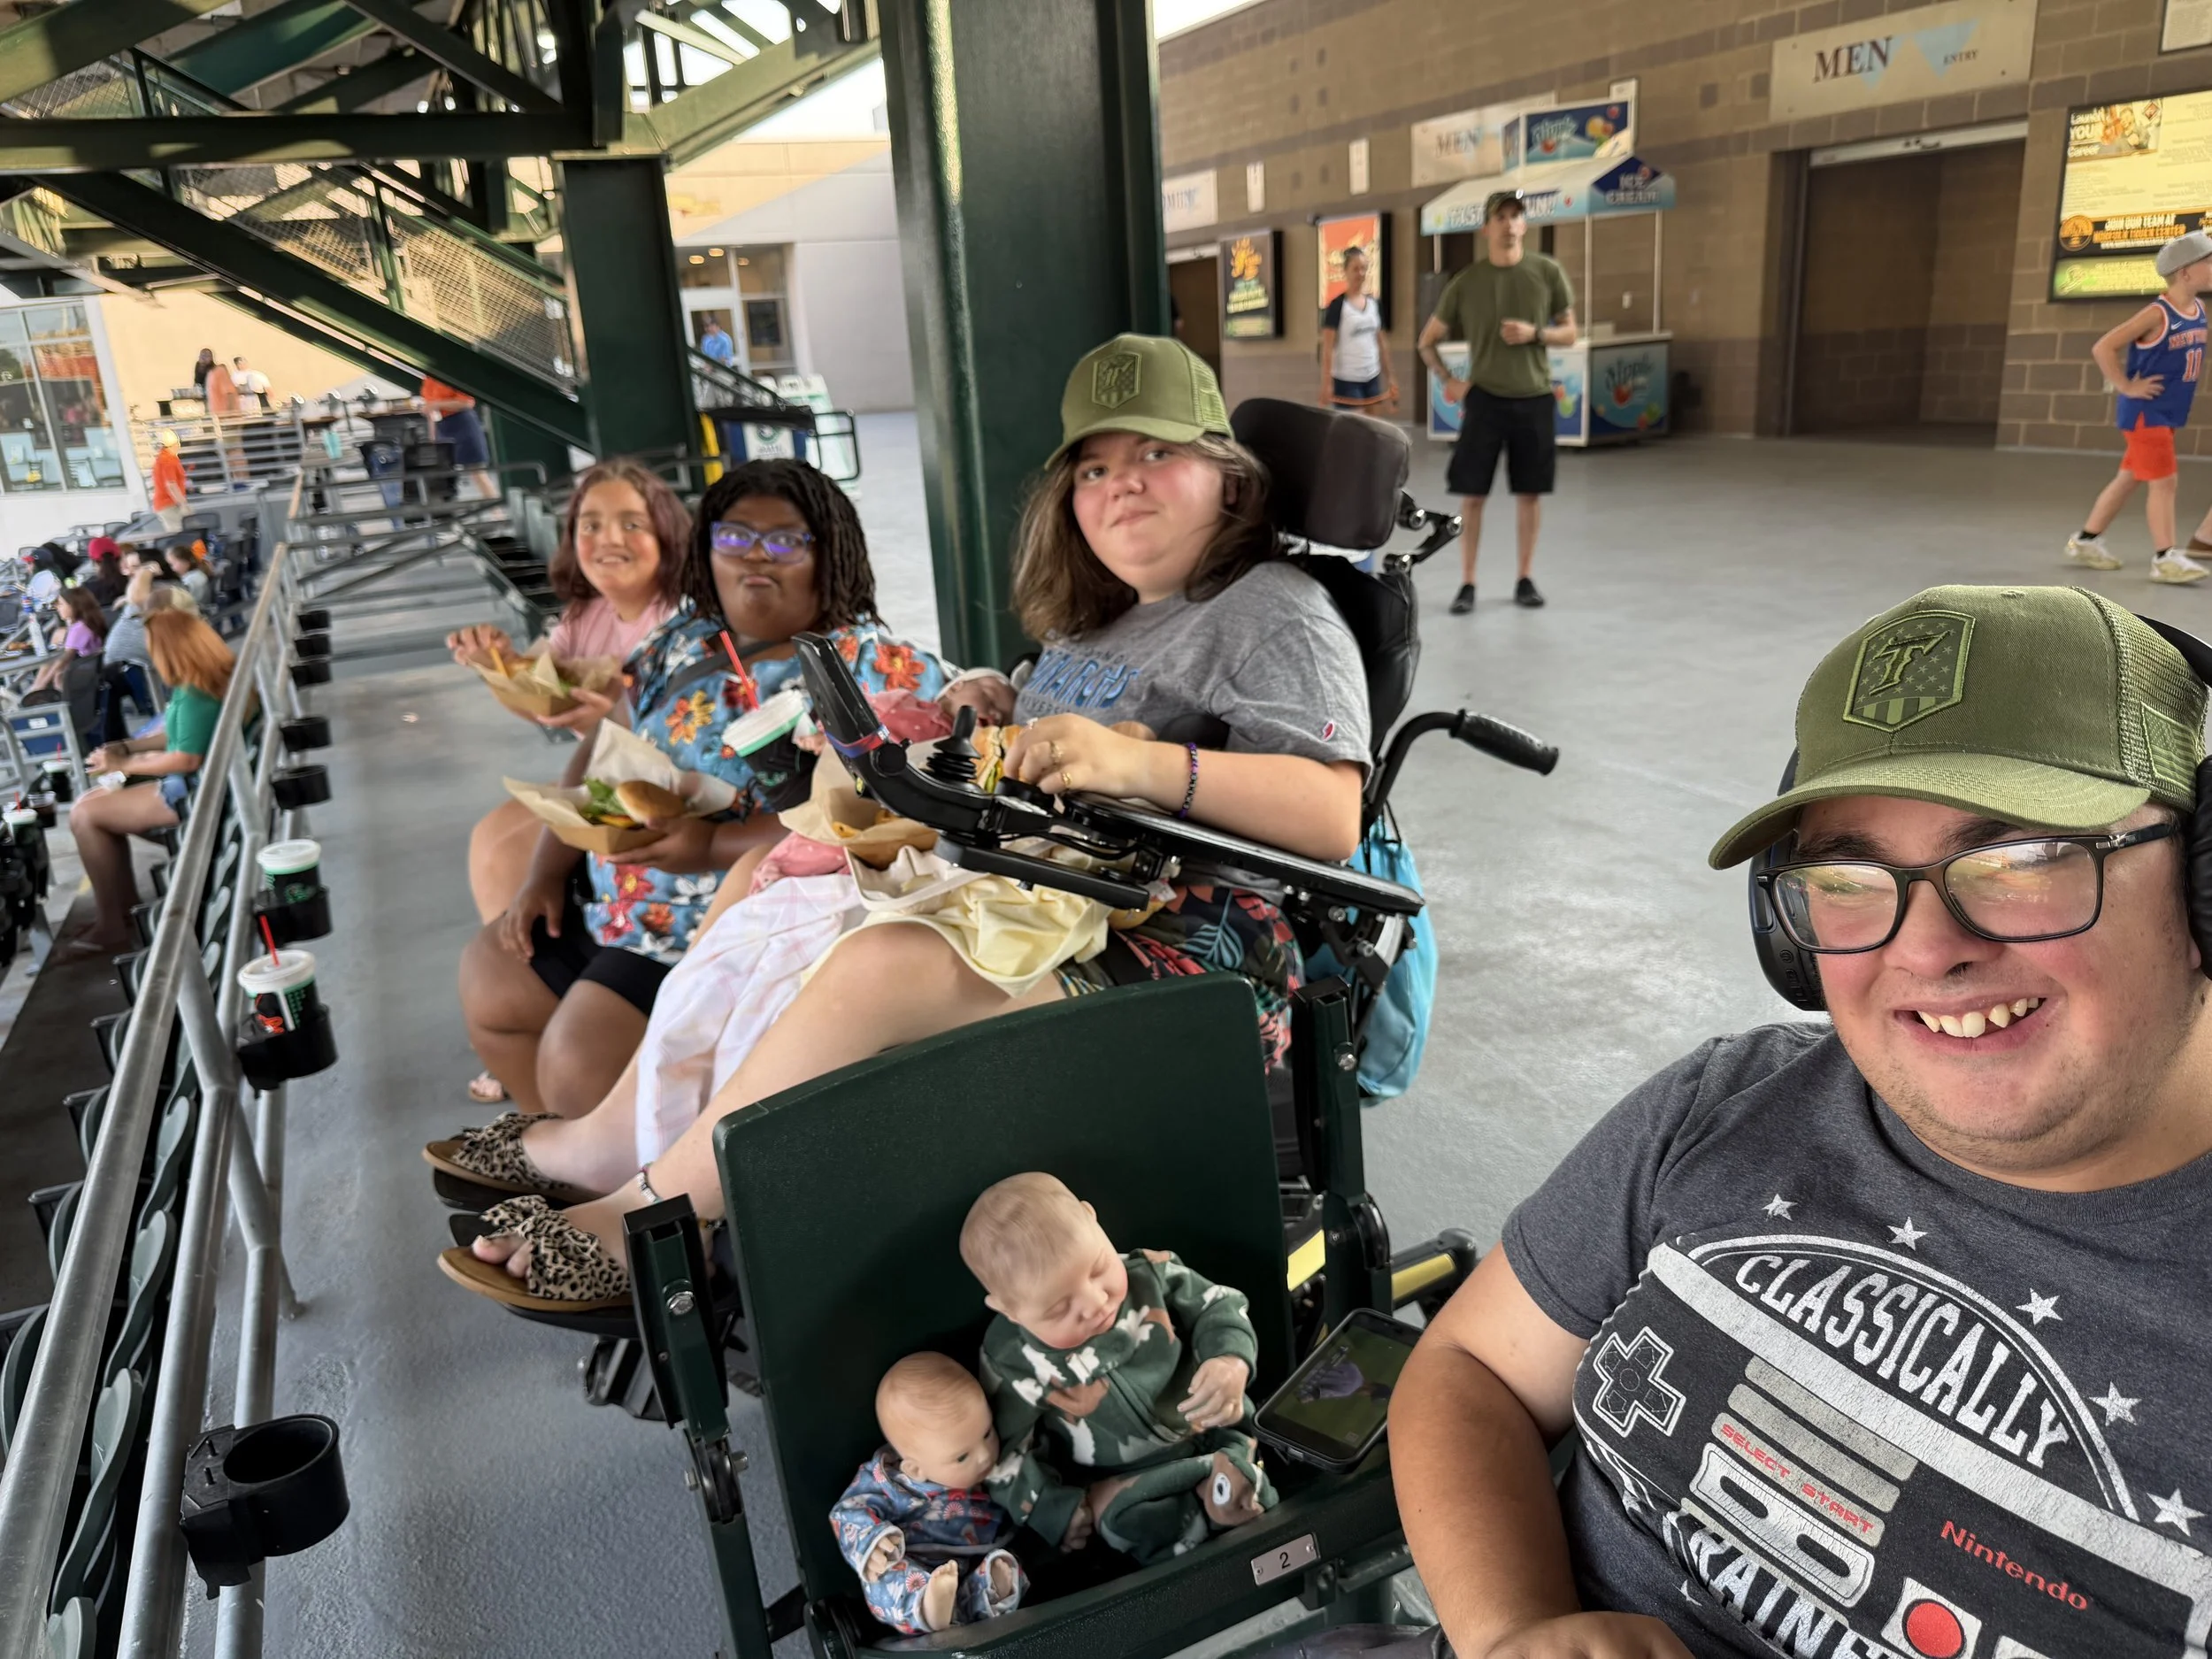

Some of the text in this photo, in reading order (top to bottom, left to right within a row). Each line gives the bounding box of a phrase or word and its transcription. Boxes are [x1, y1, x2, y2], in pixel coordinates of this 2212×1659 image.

[1812, 35, 1893, 84] MEN
[1943, 49, 1979, 65] ENTRY
[1435, 127, 1480, 157] MEN
[1447, 204, 1486, 228] TAST
[2182, 347, 2202, 382] 11
[1733, 1252, 2070, 1470] CLASSICALLY
[1720, 1423, 1874, 1534] SELECT START
[1279, 1551, 1291, 1570] 2
[1939, 1519, 2089, 1611] Nintendo
